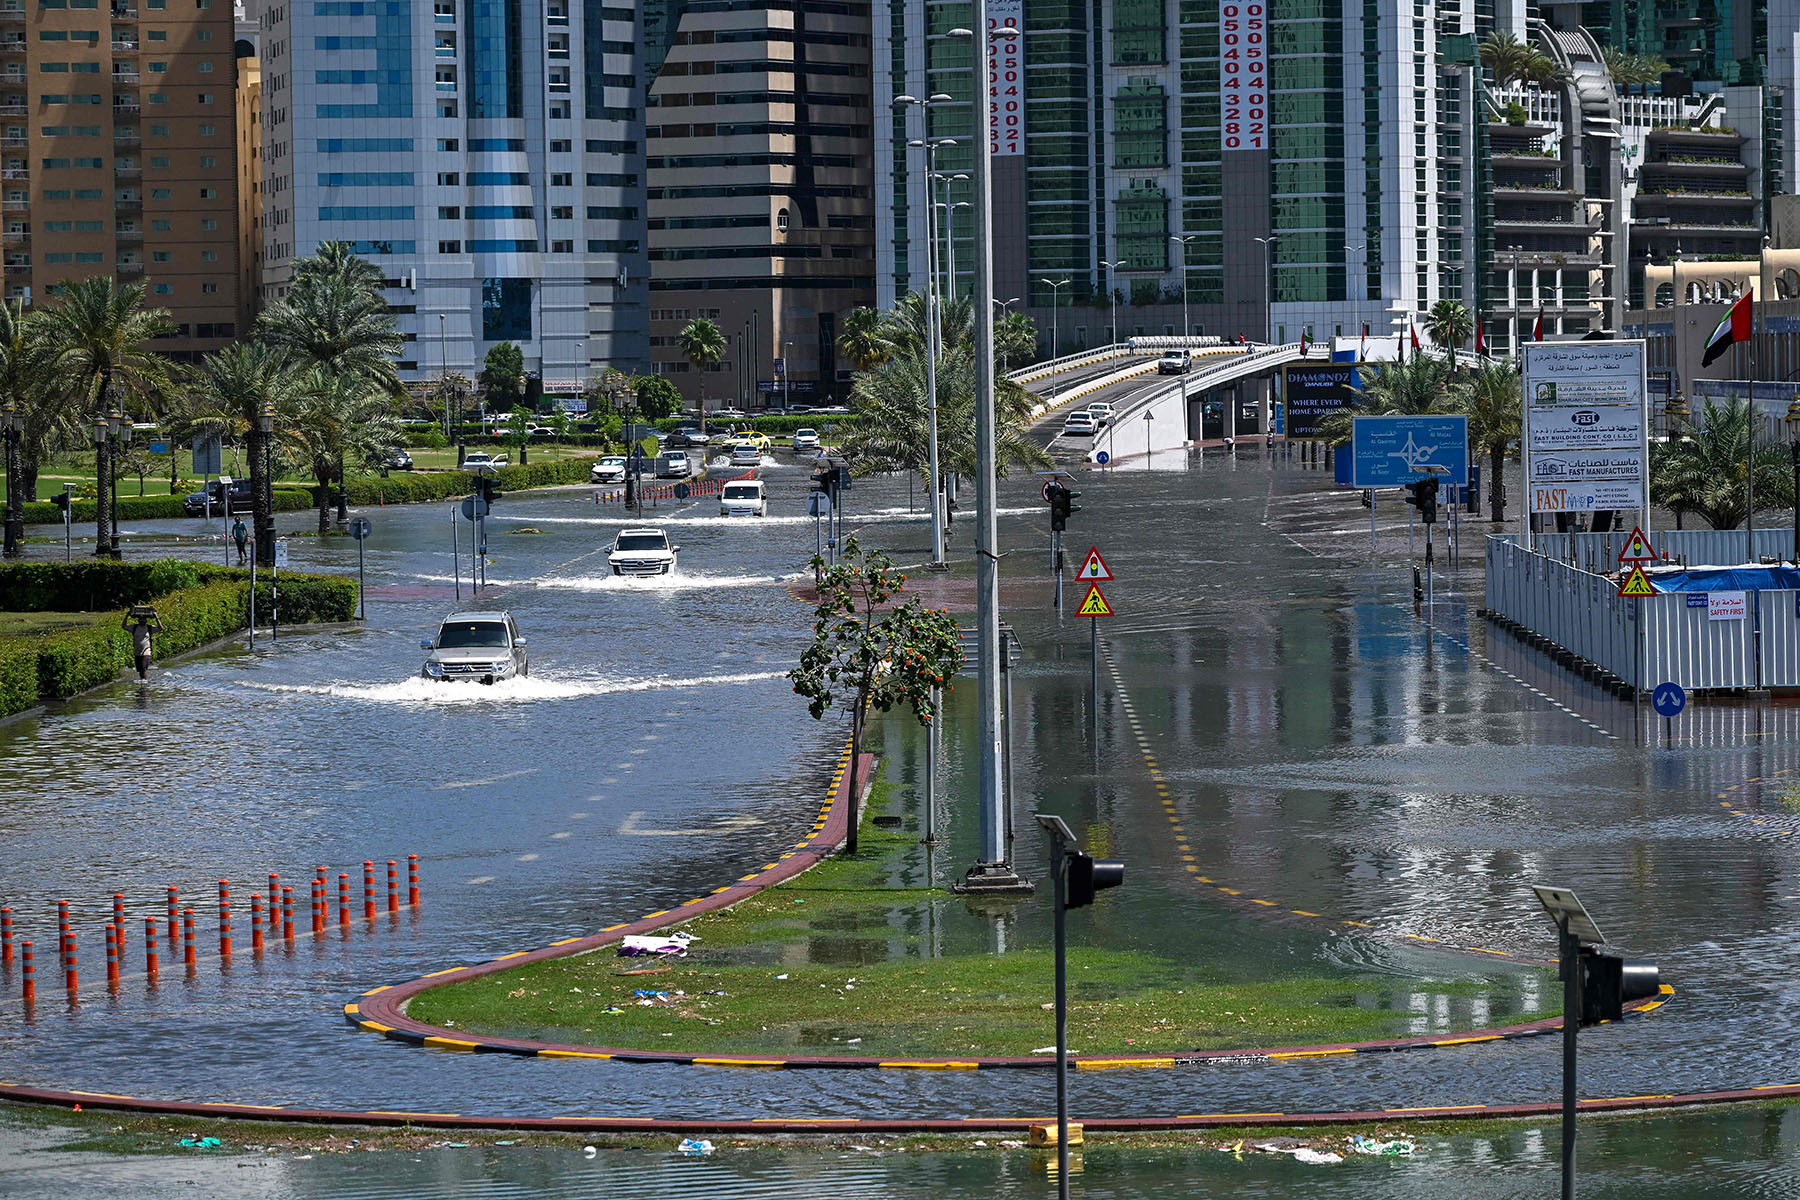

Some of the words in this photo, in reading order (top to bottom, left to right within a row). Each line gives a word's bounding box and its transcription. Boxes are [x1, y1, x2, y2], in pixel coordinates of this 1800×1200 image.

[1223, 5, 1240, 148] 0504043280
[1247, 4, 1264, 148] 0505040021
[1288, 372, 1350, 382] DIAMONDZ
[1568, 459, 1608, 468] للصناعات
[1611, 458, 1638, 467] فاست
[1586, 467, 1639, 475] MANUFACTURES
[1536, 488, 1568, 510] FAST
